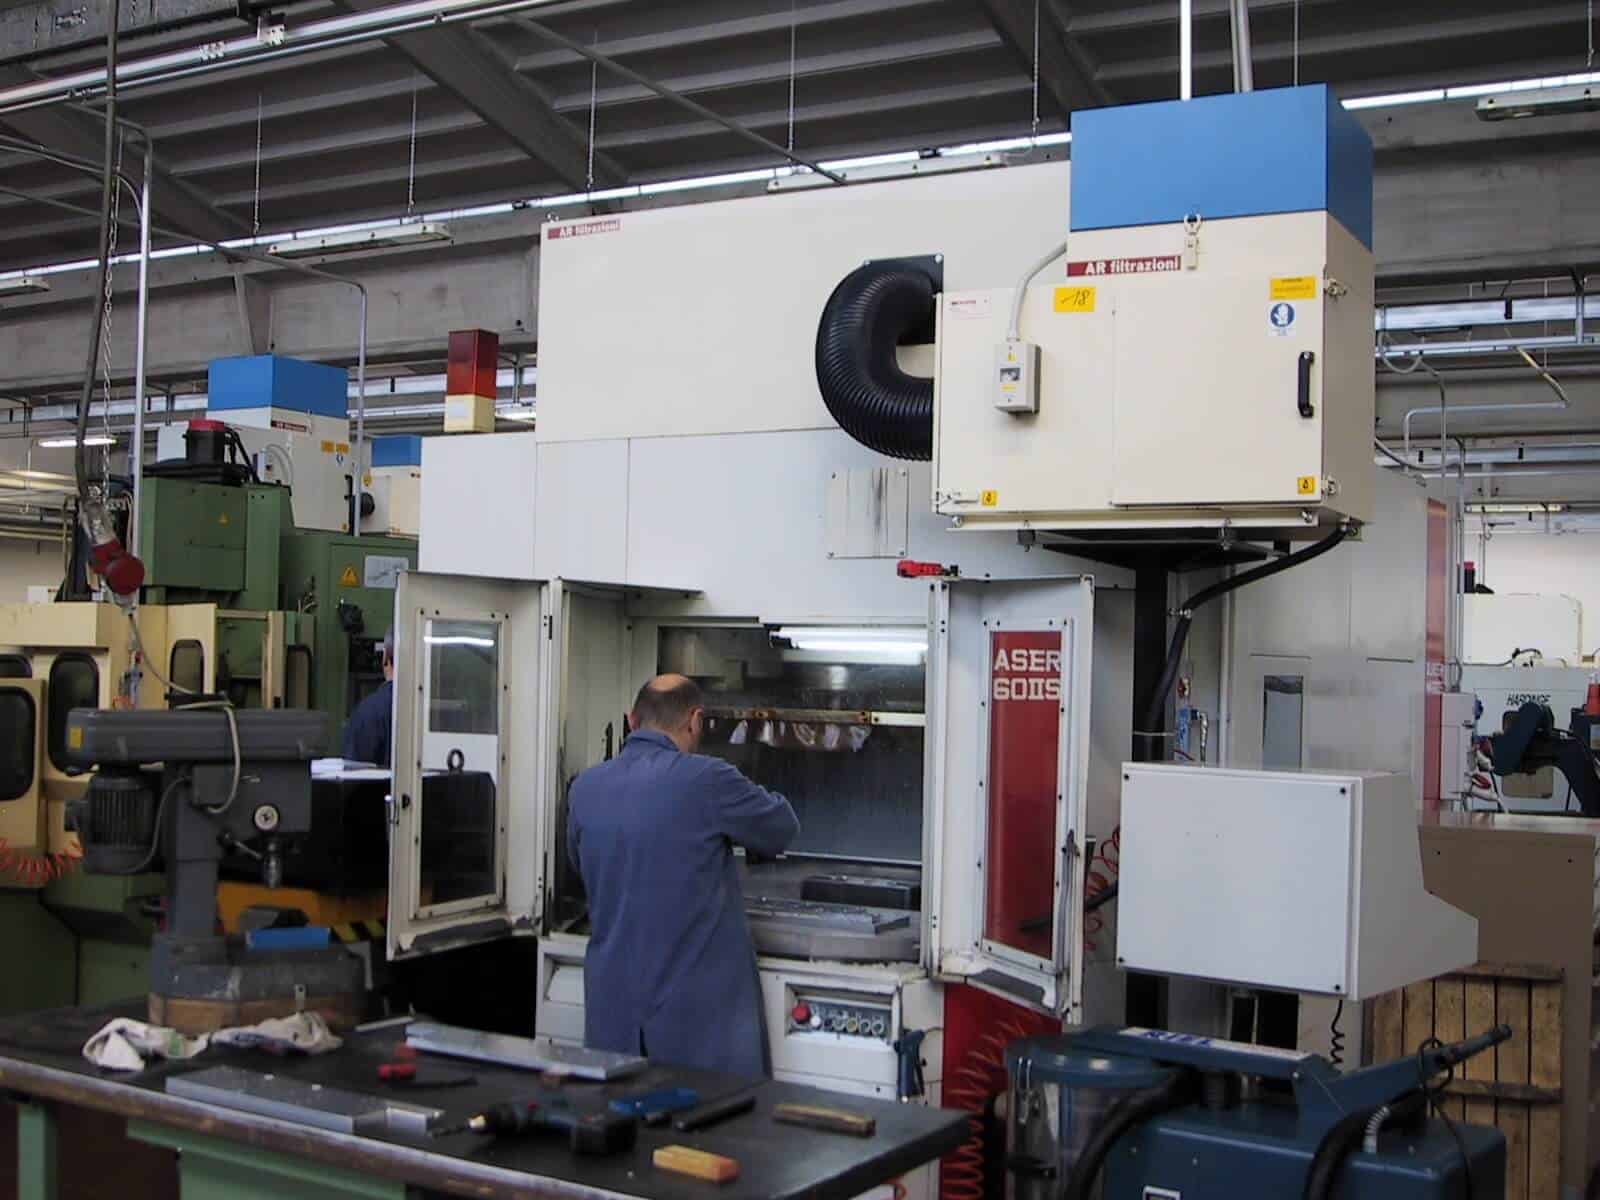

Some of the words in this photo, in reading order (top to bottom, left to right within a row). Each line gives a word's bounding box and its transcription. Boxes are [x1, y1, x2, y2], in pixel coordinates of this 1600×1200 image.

[1085, 261, 1107, 275] AR
[1110, 255, 1179, 273] filtrazioni
[994, 648, 1061, 672] ASER
